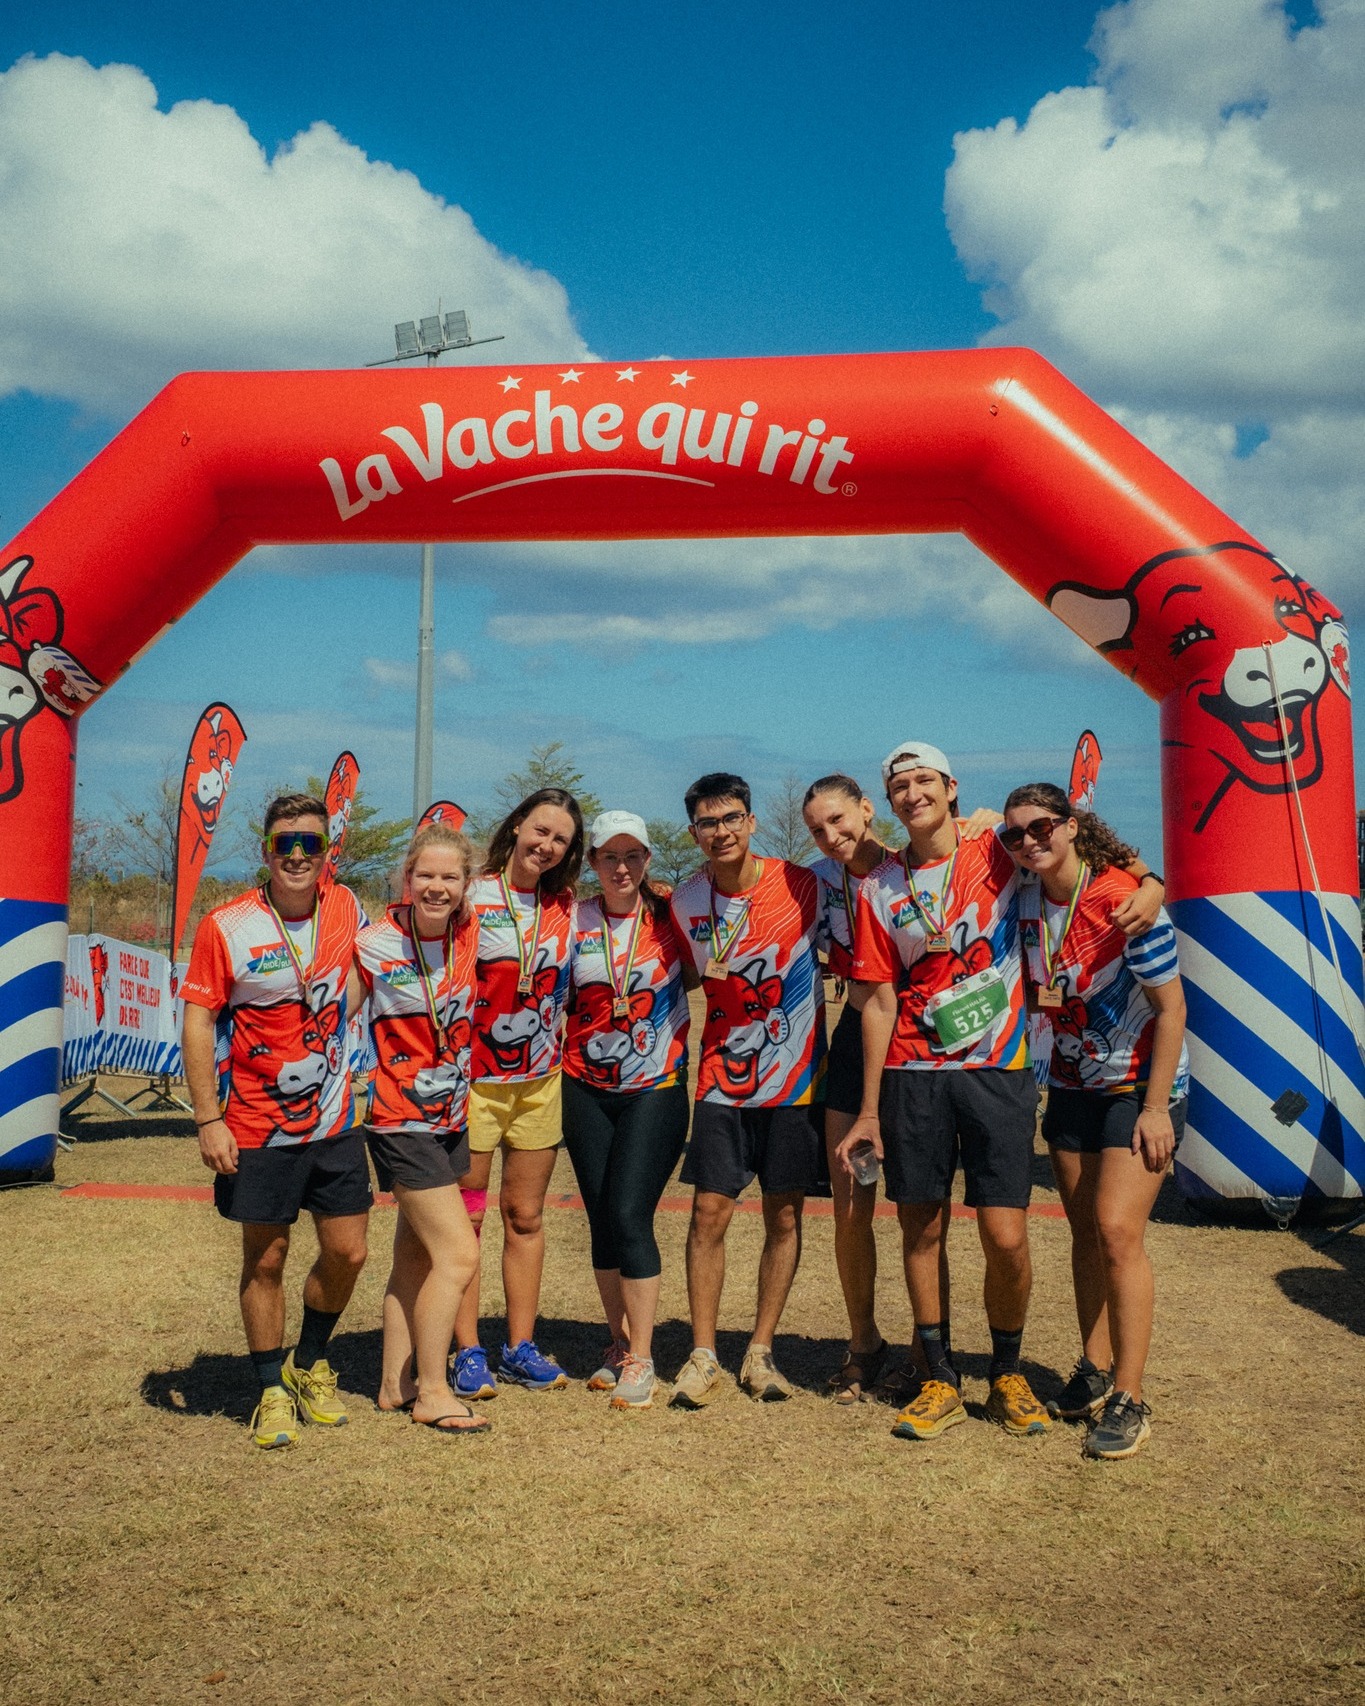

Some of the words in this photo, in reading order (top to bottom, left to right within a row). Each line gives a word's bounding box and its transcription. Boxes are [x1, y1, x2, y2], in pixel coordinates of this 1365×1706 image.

[319, 454, 403, 521] La
[380, 390, 624, 482] Vache
[637, 400, 758, 467] qui
[758, 418, 855, 494] rit
[954, 1002, 994, 1034] 525
